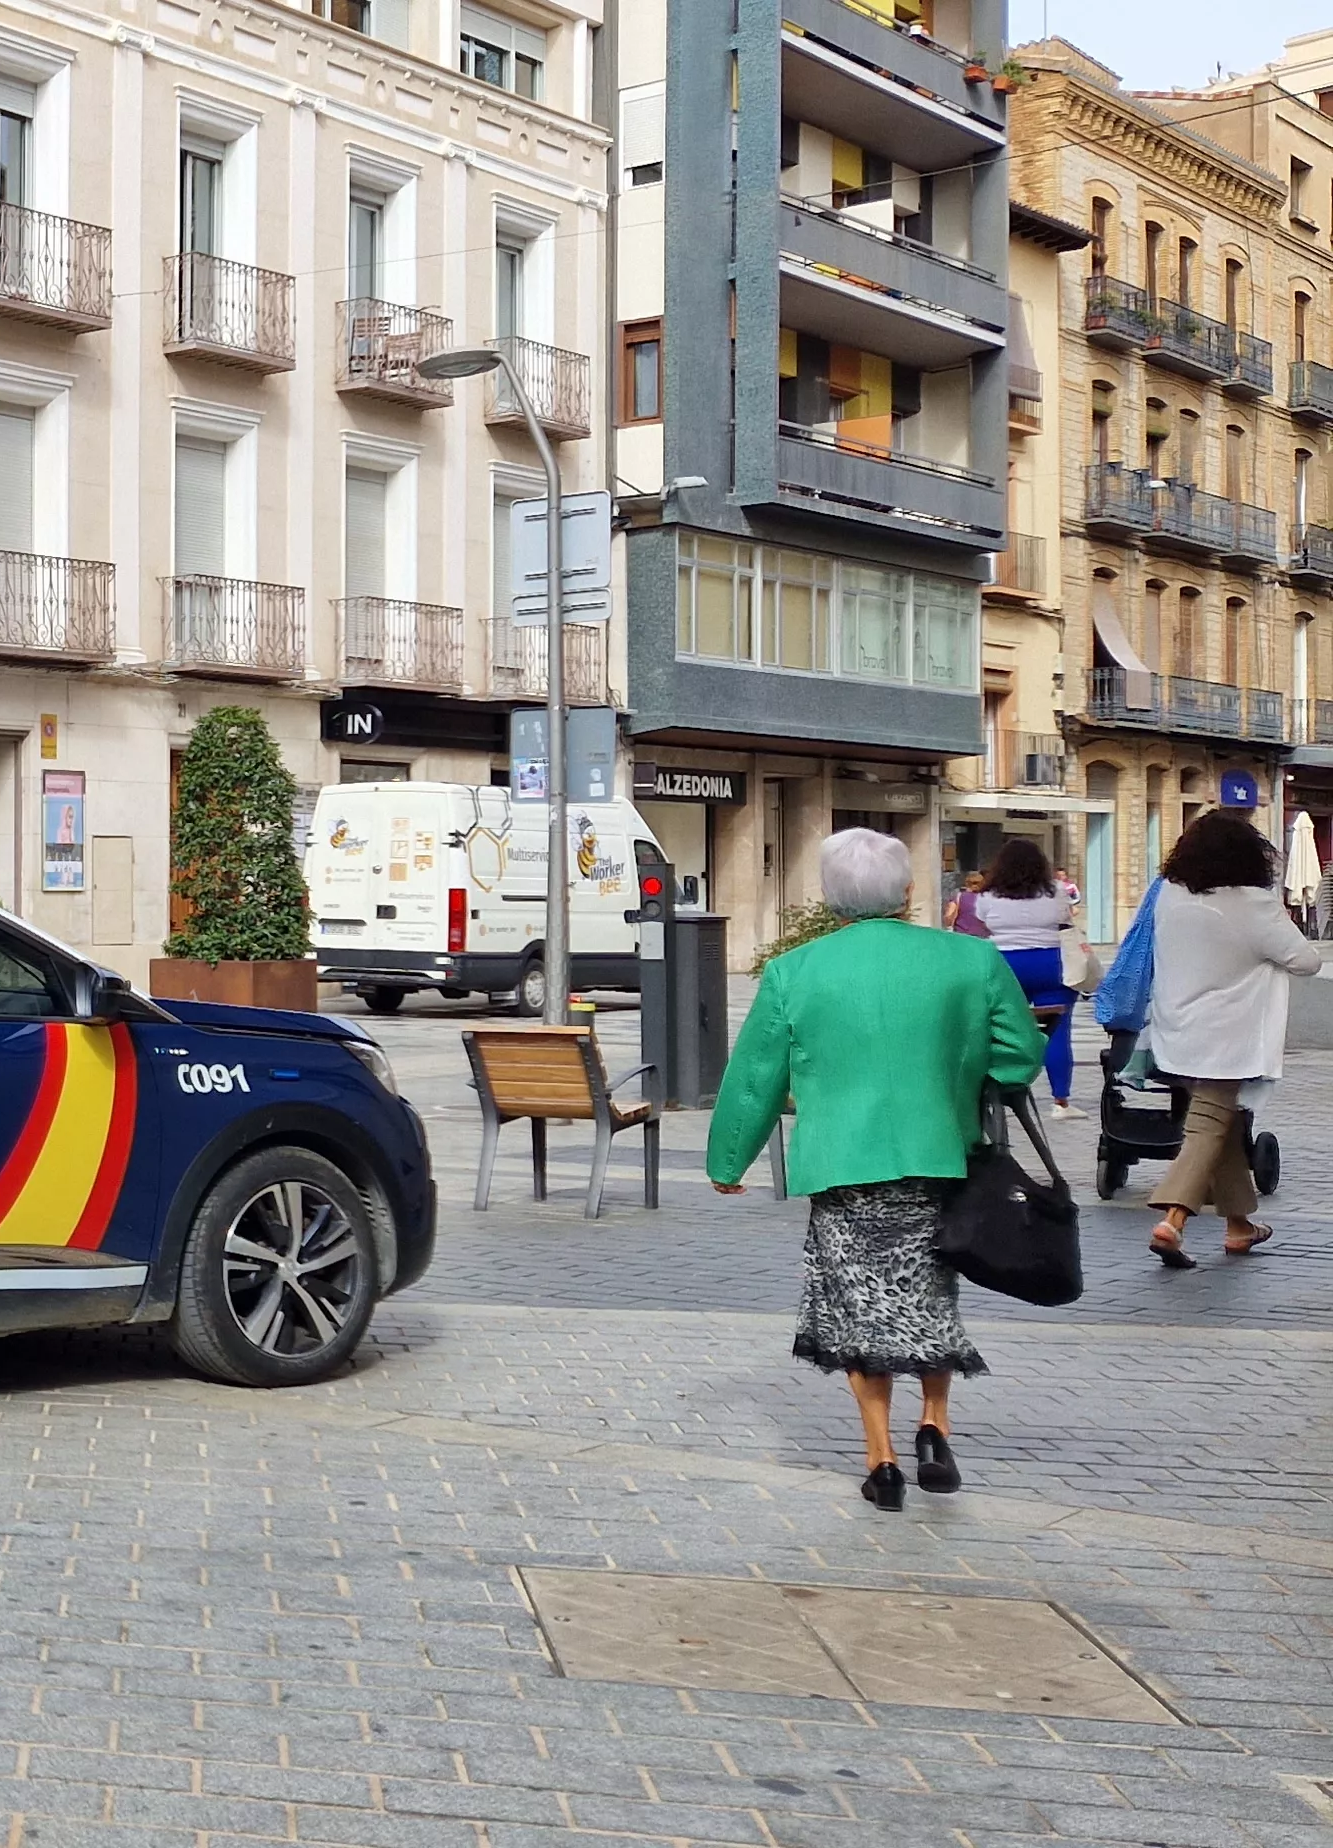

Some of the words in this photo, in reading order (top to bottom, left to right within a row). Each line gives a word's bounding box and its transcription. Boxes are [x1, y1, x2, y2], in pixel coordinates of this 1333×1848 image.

[346, 713, 373, 735] IN
[654, 772, 733, 799] ALZEDONIA
[590, 861, 625, 882] Worker
